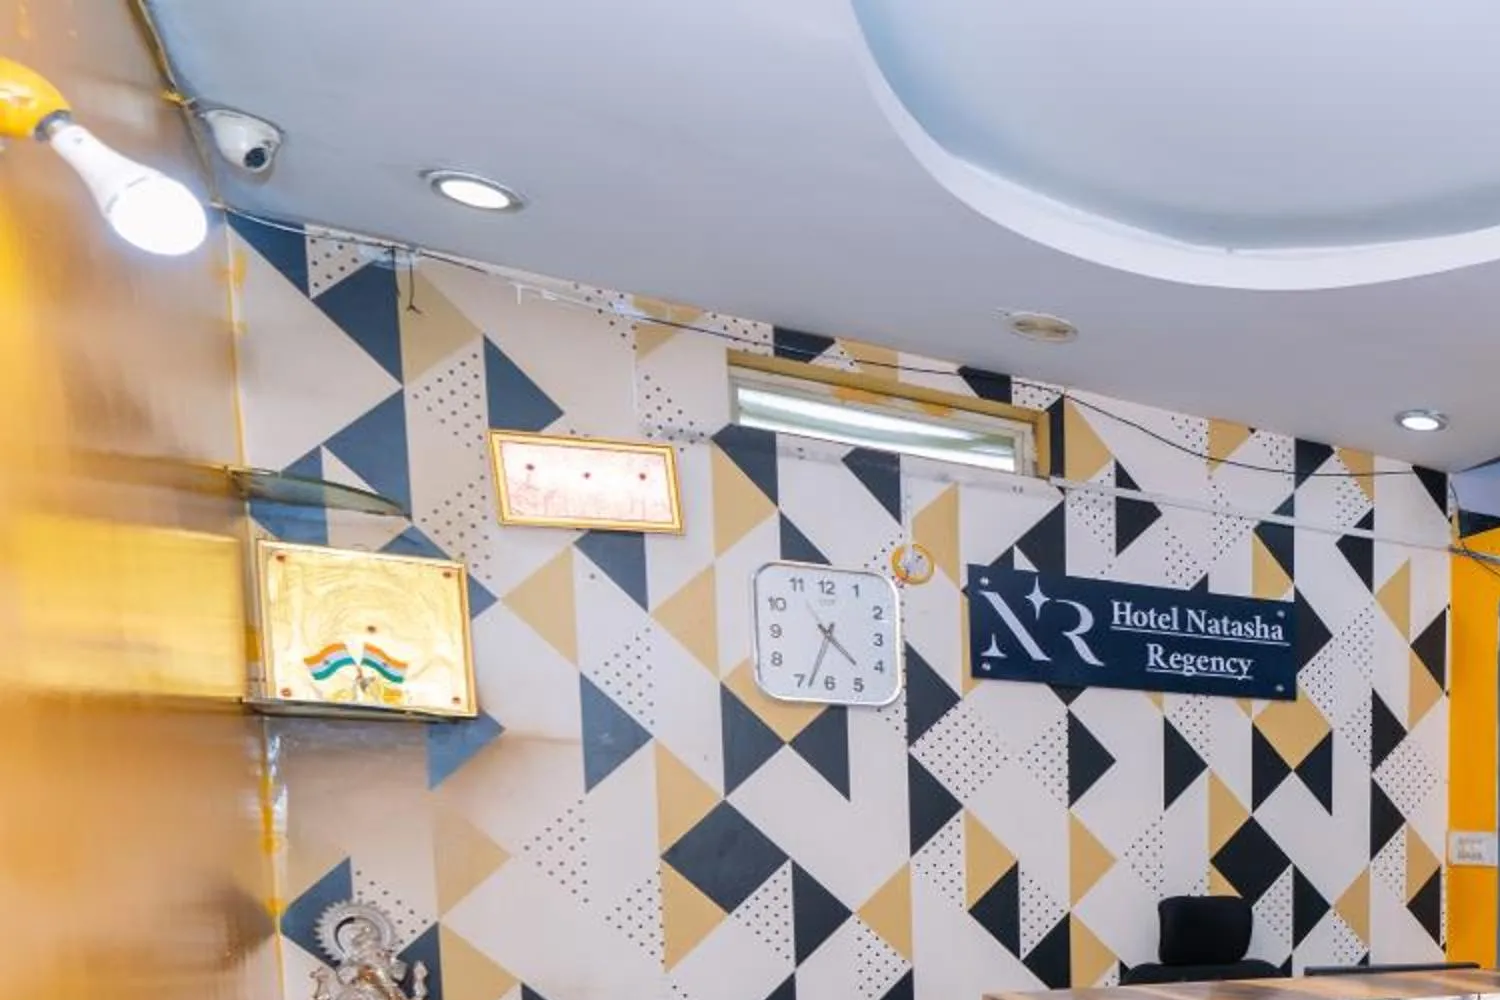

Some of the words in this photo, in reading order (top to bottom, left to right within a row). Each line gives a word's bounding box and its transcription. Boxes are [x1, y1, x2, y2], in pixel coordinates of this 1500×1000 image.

[789, 577, 804, 592] 11
[818, 580, 836, 595] 12
[852, 583, 860, 598] 1
[768, 597, 787, 612] 10
[872, 605, 884, 620] 2
[1110, 600, 1179, 632] Hotel
[1186, 606, 1284, 641] Natasha
[769, 623, 782, 639] 9
[873, 632, 884, 647] 3
[771, 651, 783, 667] 8
[873, 659, 884, 674] 4
[1146, 643, 1253, 680] Regency
[793, 673, 805, 688] 7
[823, 675, 836, 691] 6
[853, 677, 865, 693] 5
